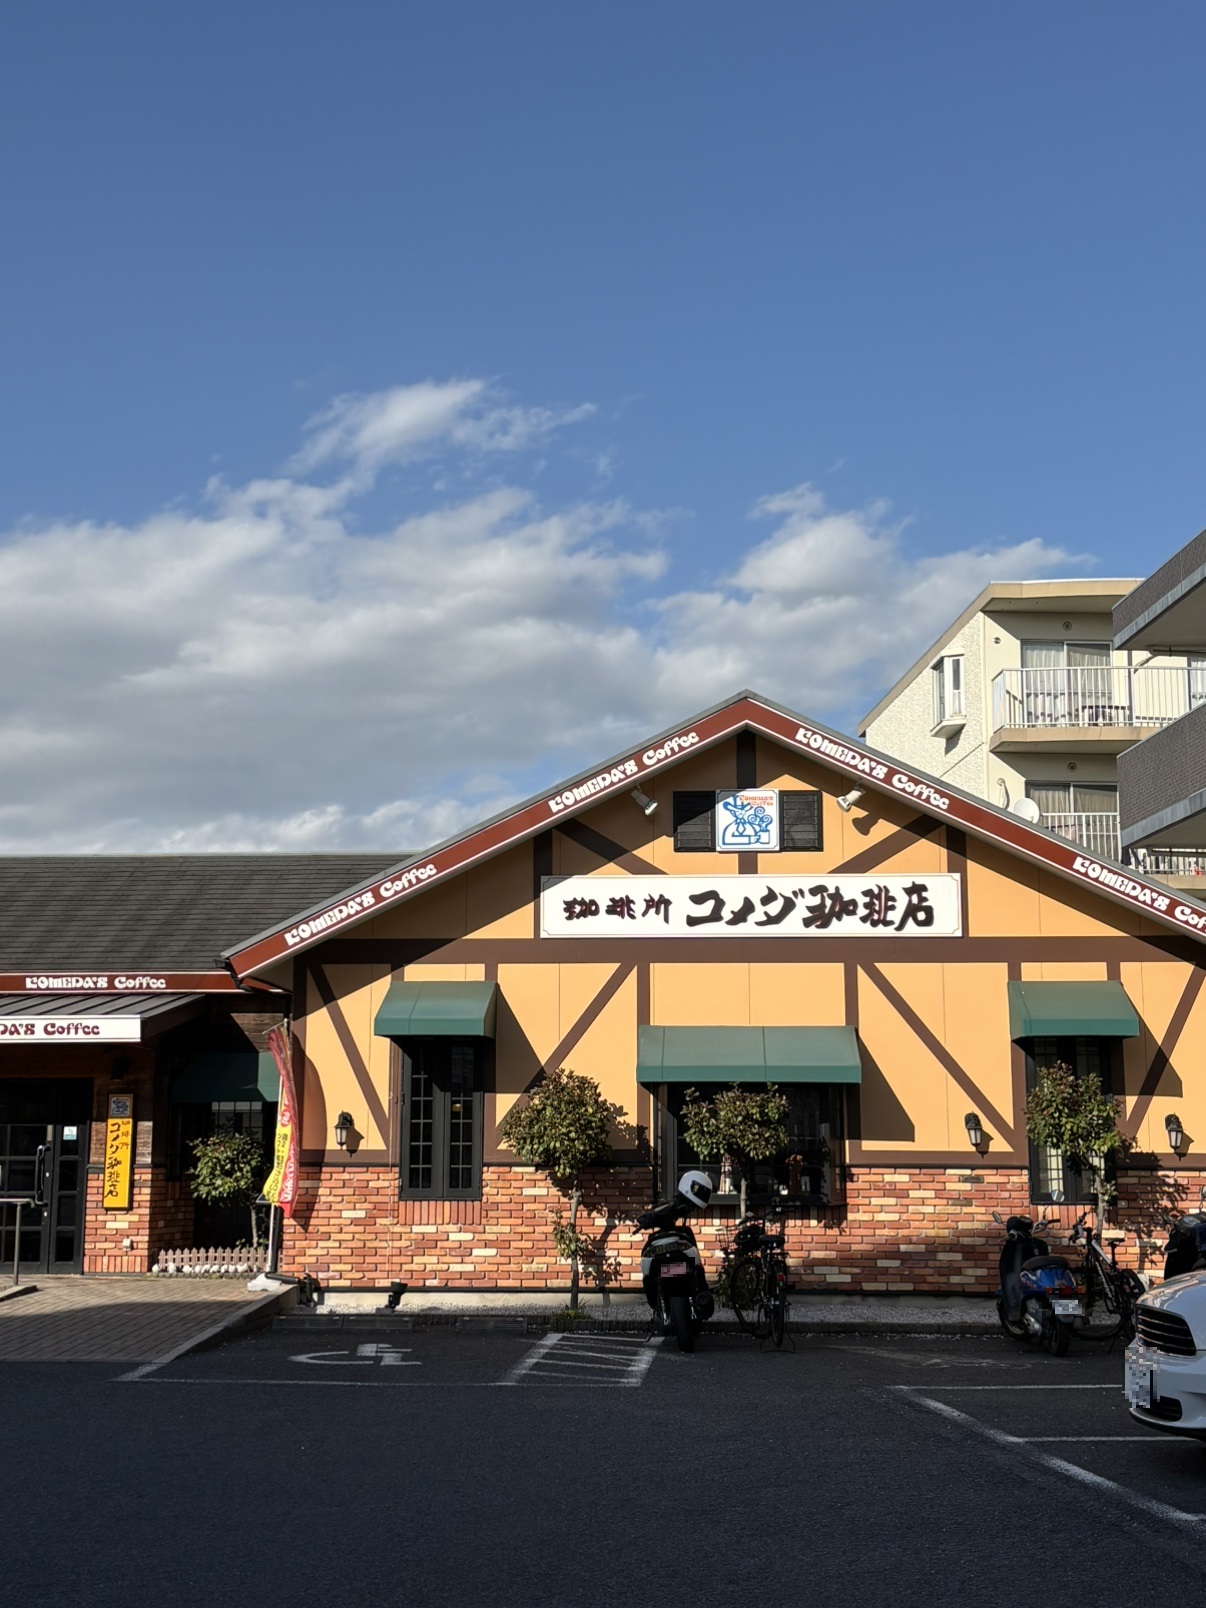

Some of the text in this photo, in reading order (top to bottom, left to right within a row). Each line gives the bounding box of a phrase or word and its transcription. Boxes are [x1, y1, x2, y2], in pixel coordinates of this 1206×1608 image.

[547, 732, 700, 813] KOMEDA'S Coffee
[794, 727, 950, 810] KOMEDA'S Coffee
[284, 863, 437, 946] KOMEDA'S Coffee
[1072, 857, 1206, 934] KOMEDA'S Cof
[25, 976, 167, 989] KOMEDA'S Coffee
[43, 1023, 100, 1036] Coffee
